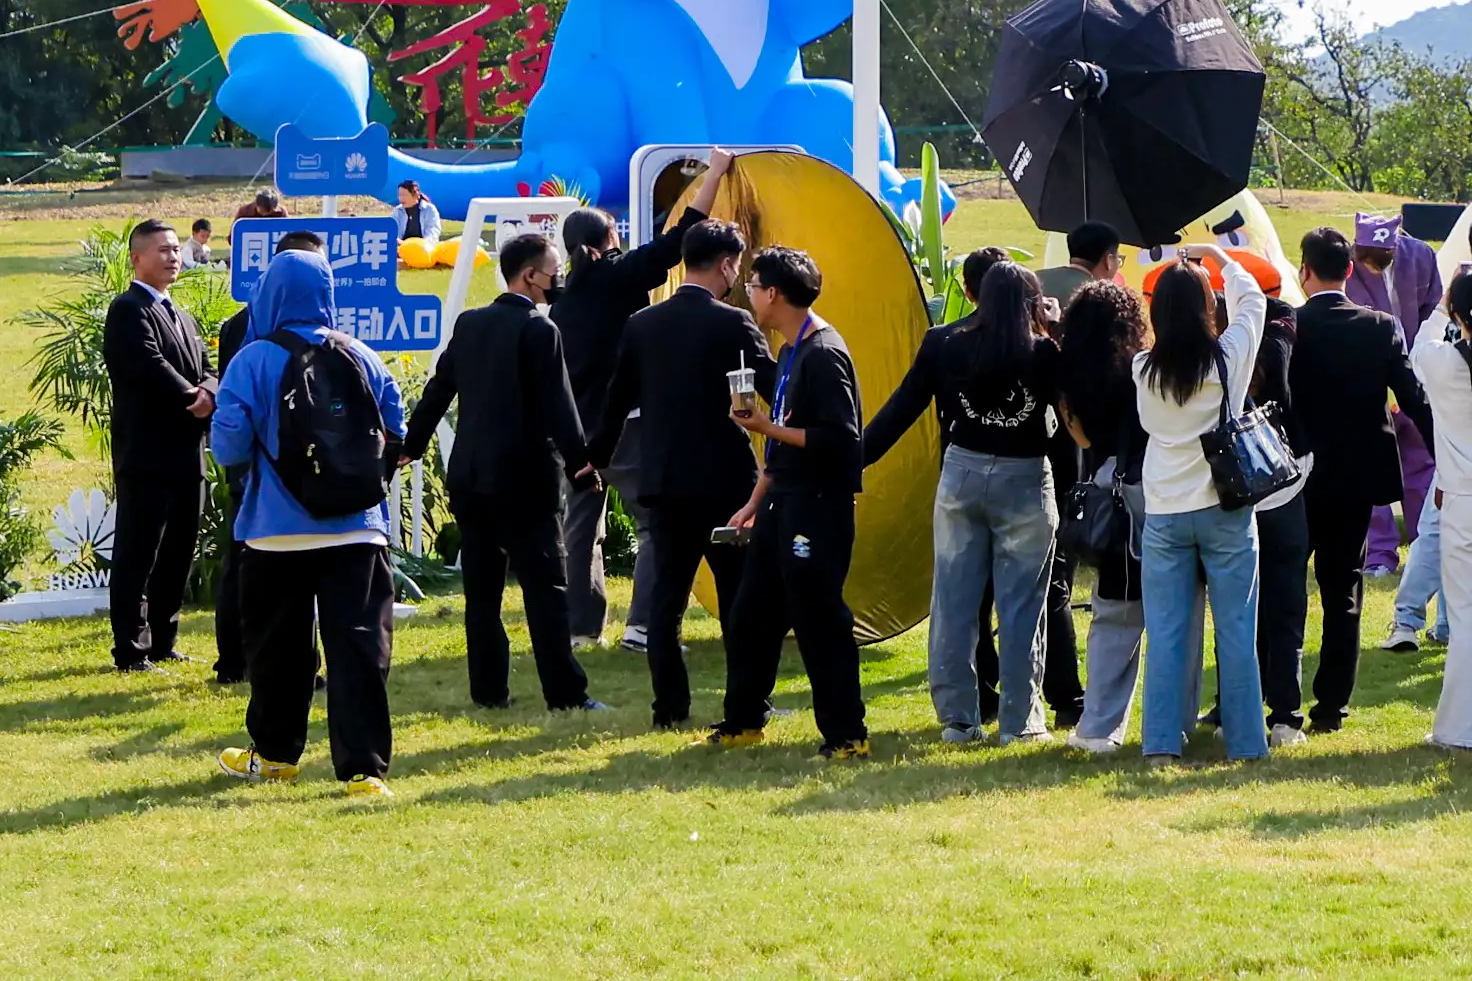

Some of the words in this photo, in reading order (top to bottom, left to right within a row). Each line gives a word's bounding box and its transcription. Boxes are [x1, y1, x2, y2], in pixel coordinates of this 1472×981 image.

[241, 230, 389, 273] 同少年
[48, 569, 111, 590] HUAW
